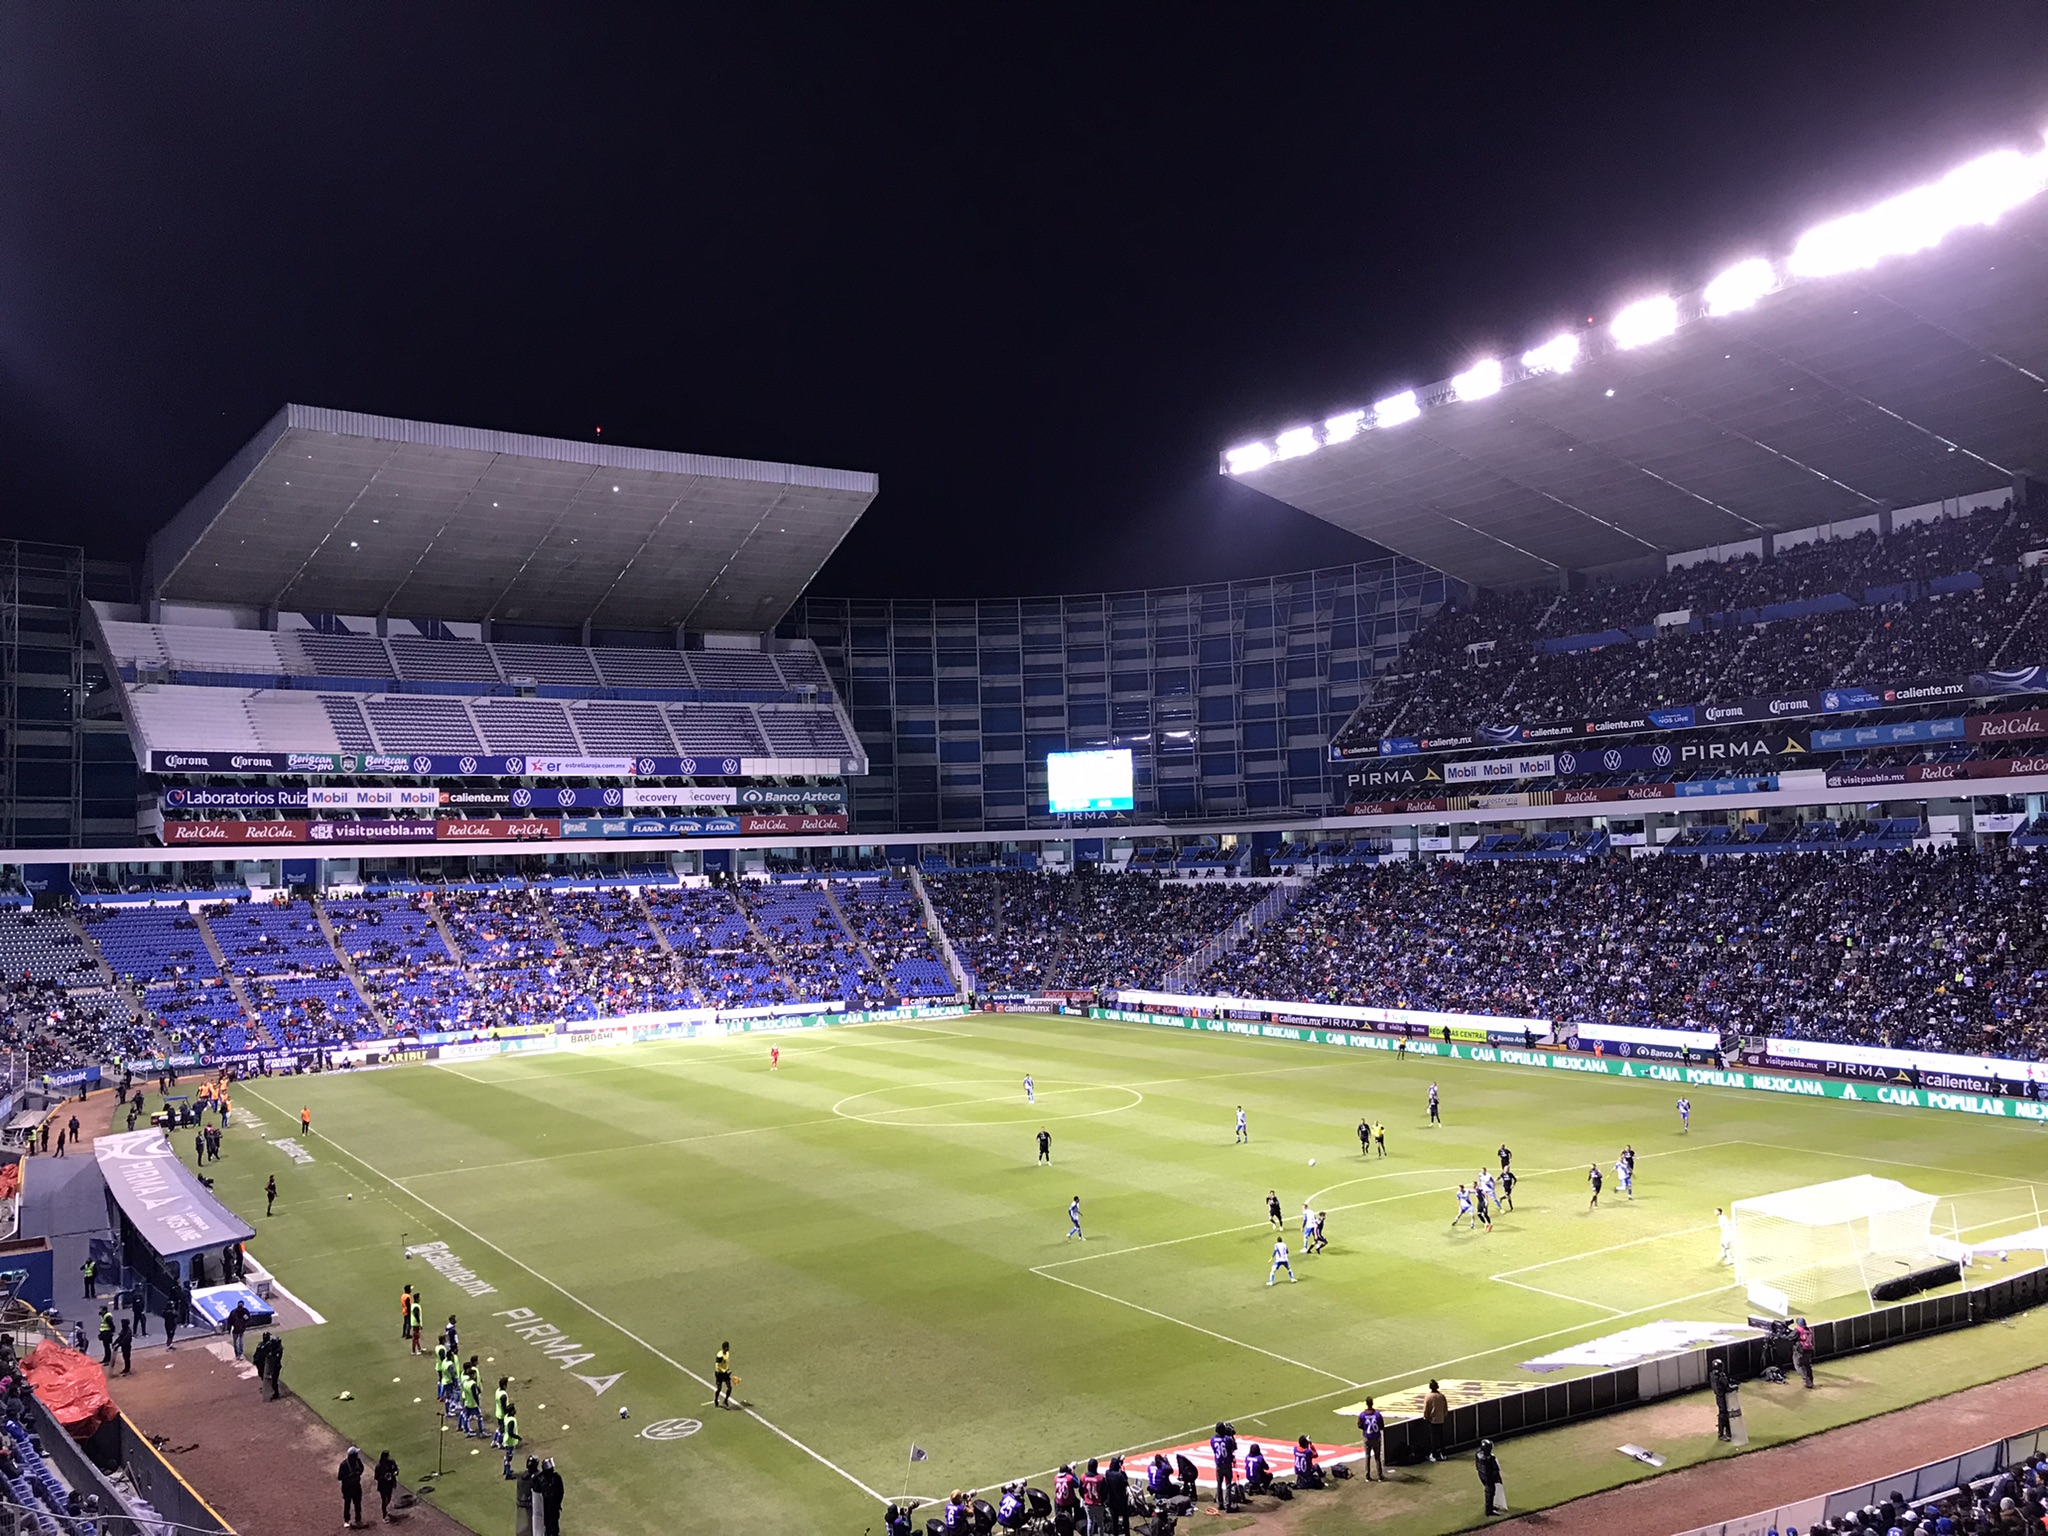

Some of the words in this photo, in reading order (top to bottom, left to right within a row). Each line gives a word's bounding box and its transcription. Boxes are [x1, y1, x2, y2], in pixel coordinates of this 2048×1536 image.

[1896, 684, 1963, 699] caliente.mx
[1769, 700, 1811, 714] Corona
[1706, 707, 1745, 721] Corona
[1530, 726, 1573, 737] caliente.mx
[1595, 719, 1645, 731] caliente.mx
[1429, 736, 1472, 747] caliente.mx
[1682, 740, 1771, 761] PIRMA
[165, 754, 210, 768] Corona
[231, 755, 273, 769] Corona
[547, 762, 561, 772] er
[1520, 760, 1550, 773] Mobil
[1448, 766, 1477, 778] Mobil
[1484, 764, 1513, 776] Mobil
[1348, 769, 1415, 786] PIRMA
[1843, 773, 1905, 785] visitpuebla.mx
[187, 790, 274, 804] Laboratorios
[279, 791, 307, 804] Ruiz
[312, 792, 348, 803] Mobil
[357, 792, 392, 803] Mobil
[400, 792, 435, 803] Mobil
[450, 793, 509, 803] caliente.mx
[765, 792, 800, 802] Banco
[802, 791, 841, 802] Azteca
[1057, 811, 1108, 821] PIRMA
[336, 825, 434, 837] visitpuebla.mx
[632, 825, 664, 833] FLANAX
[670, 824, 700, 832] FLANAX
[1004, 1004, 1050, 1012] caliente.mx
[838, 1013, 864, 1024] CAJA
[869, 1010, 912, 1021] POPULAR
[918, 1006, 964, 1017] MEXICANA
[1123, 1012, 1150, 1023] POPULAR
[1152, 1015, 1184, 1027] MEXICANA
[1279, 1014, 1320, 1026] caliente.mx
[750, 1017, 803, 1030] MEXICANA
[1321, 1018, 1358, 1029] PIRMA
[1227, 1023, 1259, 1035] POPULAR
[1262, 1026, 1300, 1039] MEXICANA
[1461, 1031, 1486, 1039] CENTRAL
[1326, 1033, 1346, 1046] CAJA
[1350, 1036, 1388, 1050] POPULAR
[212, 1052, 259, 1064] Laboratorios
[1471, 1047, 1496, 1061] CAJA
[1500, 1050, 1547, 1067] POPULAR
[1553, 1055, 1608, 1073] MEXICANA
[1651, 1049, 1673, 1058] Banco
[1766, 1057, 1818, 1069] visitpuebla.mx
[1826, 1061, 1888, 1079] PIRMA
[1650, 1065, 1681, 1081] CAJA
[1686, 1069, 1746, 1088] POPULAR
[1752, 1075, 1825, 1096] MEXICANA
[1877, 1087, 1920, 1106] CAJA
[1927, 1092, 2005, 1115] POPULAR
[491, 1307, 596, 1370] PIRMA
[1365, 1417, 1379, 1434] 26
[1214, 1442, 1228, 1459] 36
[1248, 1460, 1254, 1476] 1
[1150, 1468, 1157, 1484] 7
[1000, 1503, 1016, 1518] 25
